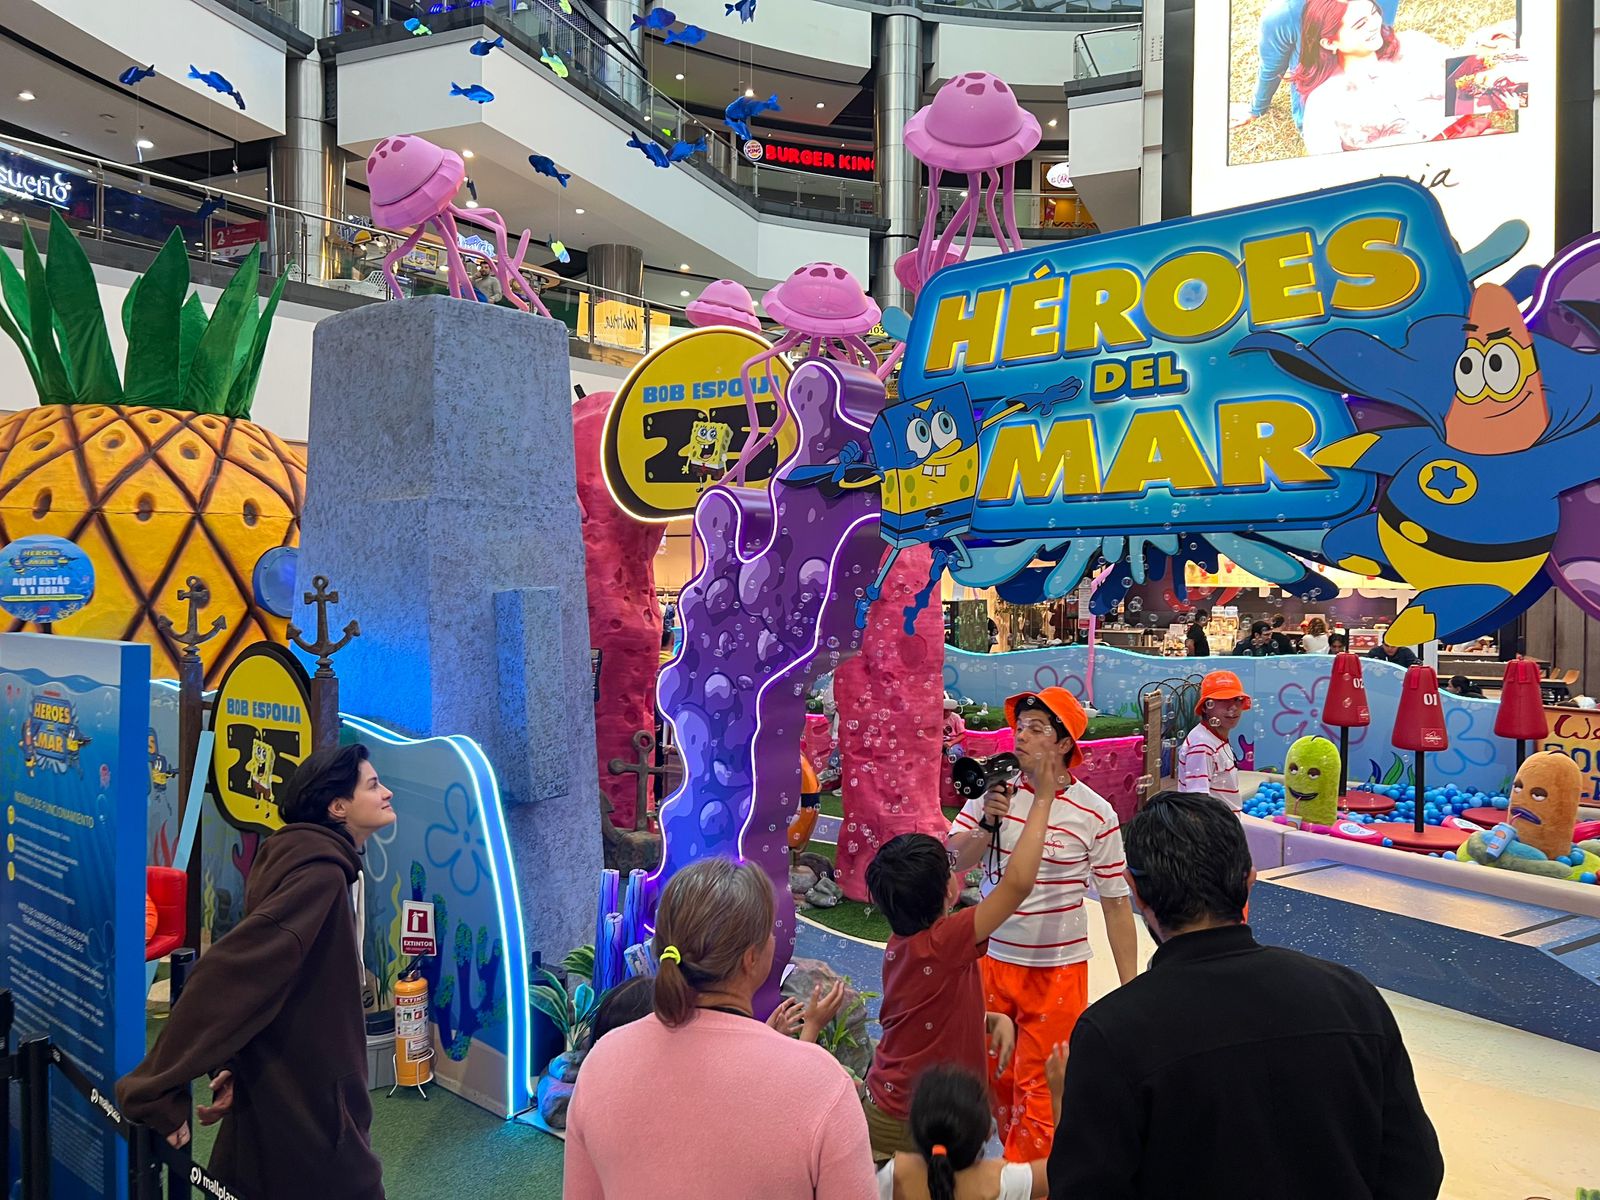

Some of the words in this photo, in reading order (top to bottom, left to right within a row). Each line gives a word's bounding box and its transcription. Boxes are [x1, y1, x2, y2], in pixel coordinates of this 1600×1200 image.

[765, 144, 835, 168] BURGER
[839, 154, 875, 171] KIN
[923, 217, 1421, 372] HÉROES
[1094, 358, 1184, 394] DEL
[643, 384, 685, 403] BOB
[643, 401, 778, 483] 25
[979, 401, 1333, 500] MAR
[12, 575, 37, 586] AQUÍ
[39, 575, 70, 586] ESTÁS
[20, 587, 27, 595] A
[30, 587, 35, 595] 1
[38, 586, 65, 595] HORA
[1353, 677, 1365, 689] 02
[227, 698, 249, 716] BOB
[252, 701, 302, 724] ESPONJA
[1423, 693, 1438, 706] 01
[37, 731, 64, 753] MAR
[203, 1175, 239, 1200] mallpla
